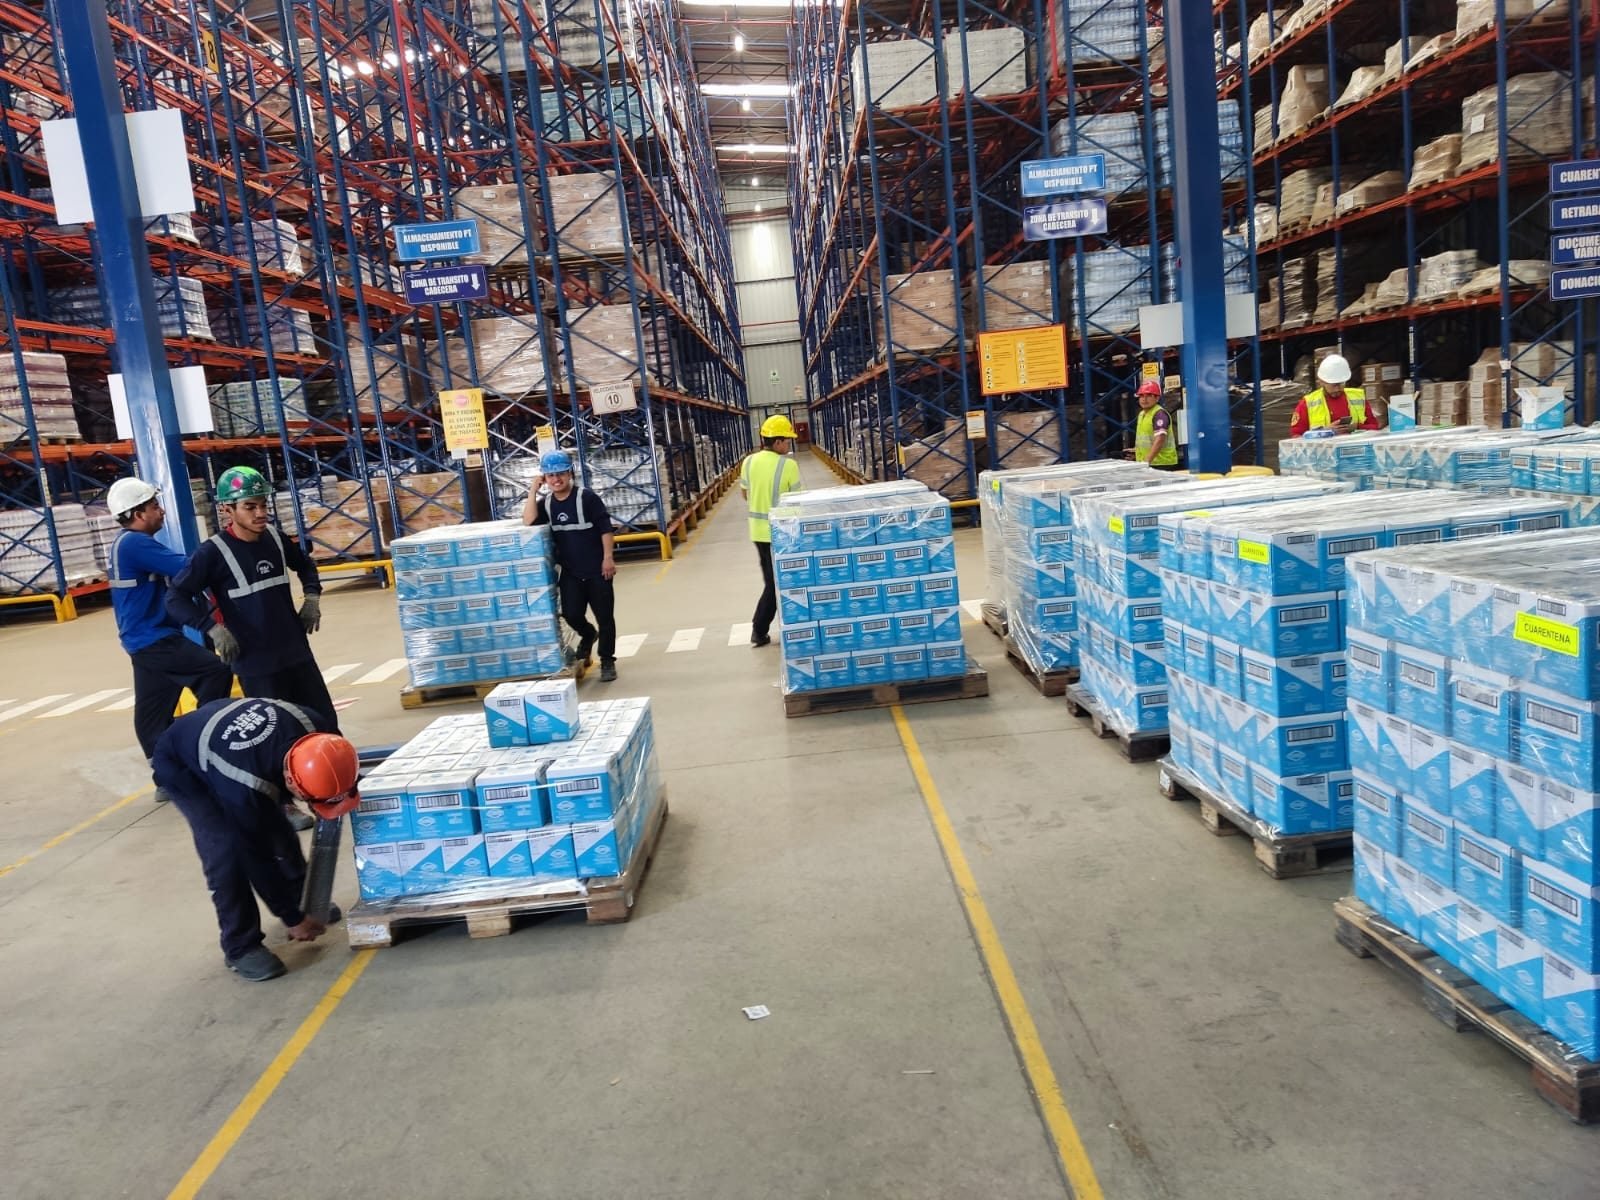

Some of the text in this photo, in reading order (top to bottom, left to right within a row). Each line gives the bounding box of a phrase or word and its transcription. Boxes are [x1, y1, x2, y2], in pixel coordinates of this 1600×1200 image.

[207, 40, 216, 65] 8
[1028, 164, 1098, 179] ALMACENAMIENTO PT
[1560, 168, 1600, 183] CUAREN
[1044, 177, 1083, 189] DISPONIBLE
[1030, 209, 1089, 224] ZONA DE TRANSITO
[1561, 205, 1600, 219] RETRAB
[1042, 219, 1077, 232] CABECERA
[403, 229, 472, 243] ALMACENAMIENTO PT
[420, 241, 459, 253] DISPONIBLE
[411, 274, 469, 289] ZONA DE TRANSITO
[1560, 275, 1600, 290] DONACI
[424, 284, 458, 296] CABECERA
[608, 393, 620, 405] 10
[1523, 622, 1571, 645] CUARENTENA
